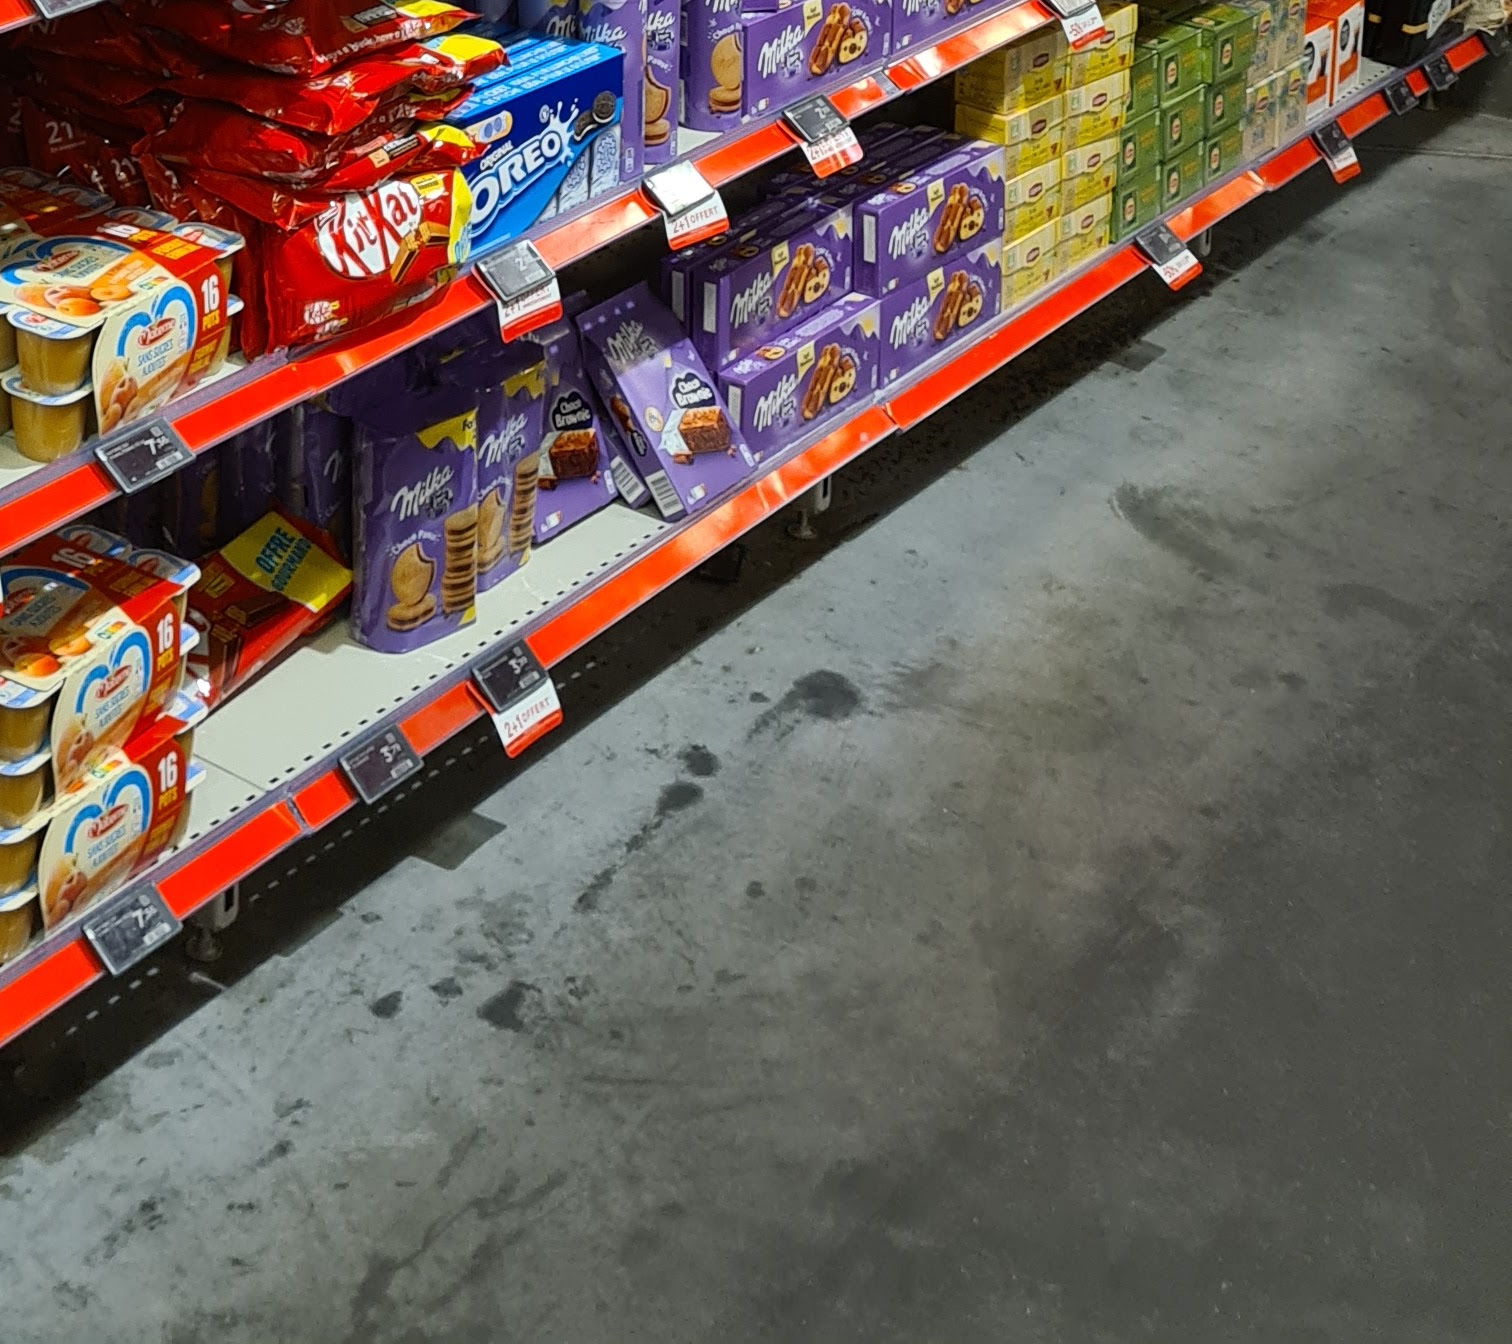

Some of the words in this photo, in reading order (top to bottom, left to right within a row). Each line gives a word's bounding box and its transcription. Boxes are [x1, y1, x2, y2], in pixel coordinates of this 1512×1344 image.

[470, 133, 564, 226] OREO
[316, 180, 423, 278] KitKat
[199, 274, 219, 315] 16
[391, 465, 455, 521] Milka
